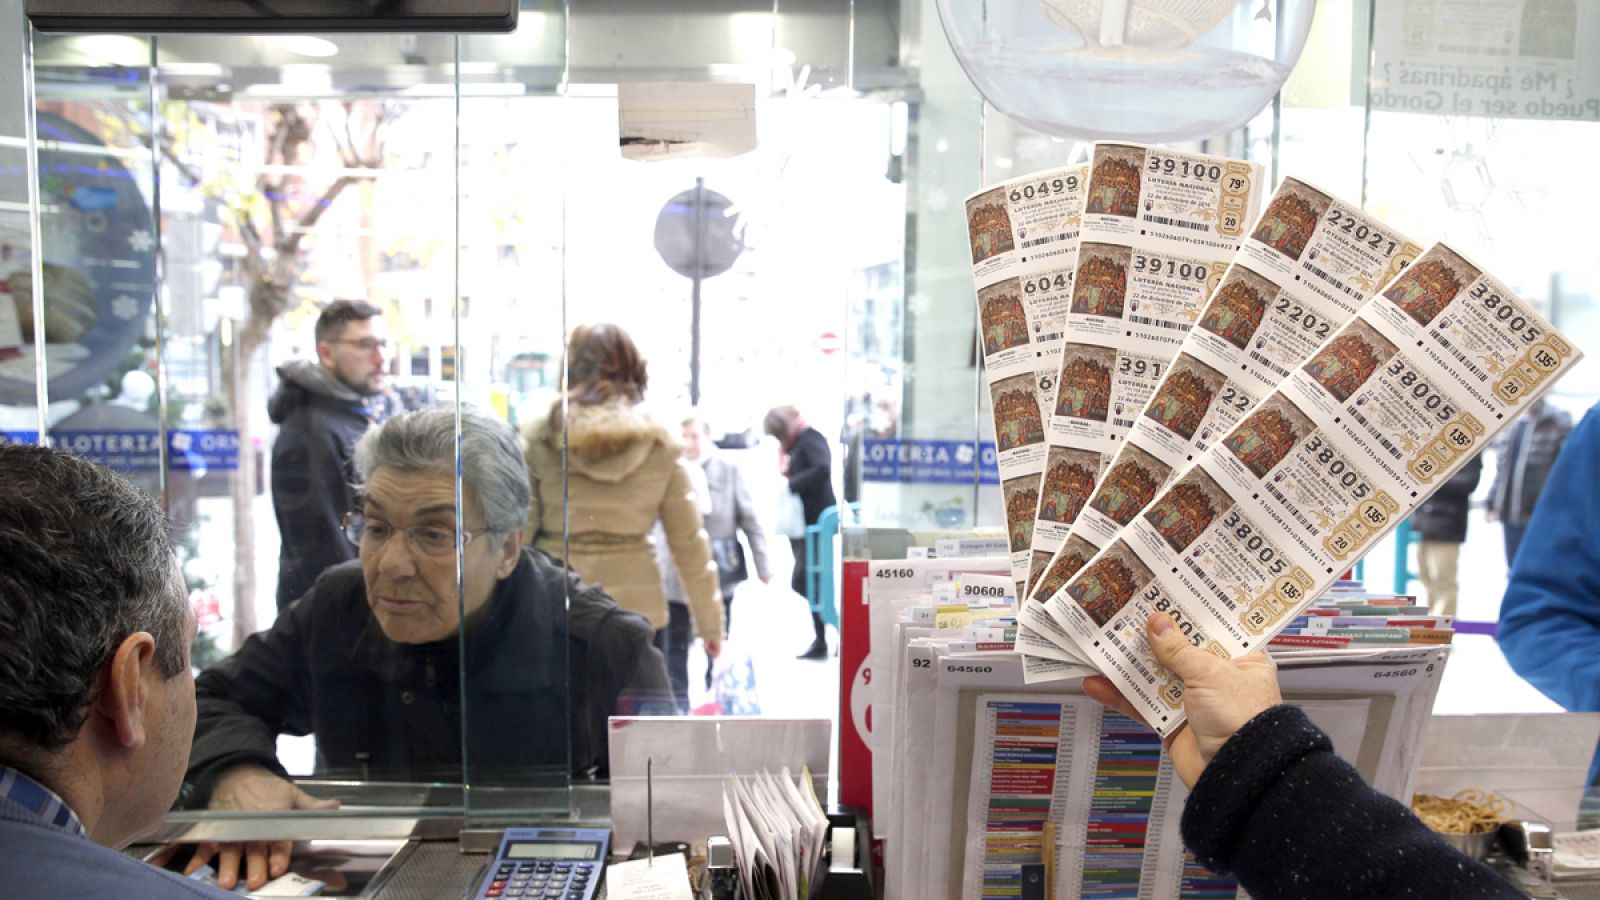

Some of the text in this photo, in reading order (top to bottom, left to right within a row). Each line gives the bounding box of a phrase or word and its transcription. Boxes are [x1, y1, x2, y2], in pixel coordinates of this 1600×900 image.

[1148, 156, 1221, 181] 39100
[1007, 175, 1078, 203] 60499
[1179, 182, 1213, 192] NACIONAL
[1224, 217, 1235, 227] 20
[1326, 208, 1397, 256] 22021
[1134, 255, 1207, 280] 39100
[1165, 282, 1200, 292] NACIONAL
[1469, 280, 1540, 344] 38005
[1487, 321, 1519, 351] NACIONAL
[1386, 356, 1456, 423] 38005
[1503, 380, 1518, 395] 20
[1221, 386, 1256, 416] 22
[1402, 399, 1434, 429] NACIONAL
[1304, 434, 1371, 500] 38005
[1418, 458, 1433, 473] 20
[1222, 509, 1288, 576] 38005
[1333, 536, 1348, 550] 20
[876, 569, 914, 579] 45160
[1237, 552, 1267, 582] NACIONAL
[964, 585, 1005, 597] 90608
[1251, 610, 1264, 625] 20
[912, 659, 931, 668] 92
[948, 665, 993, 673] 64560
[1373, 669, 1417, 679] 64560
[1168, 685, 1182, 699] 20
